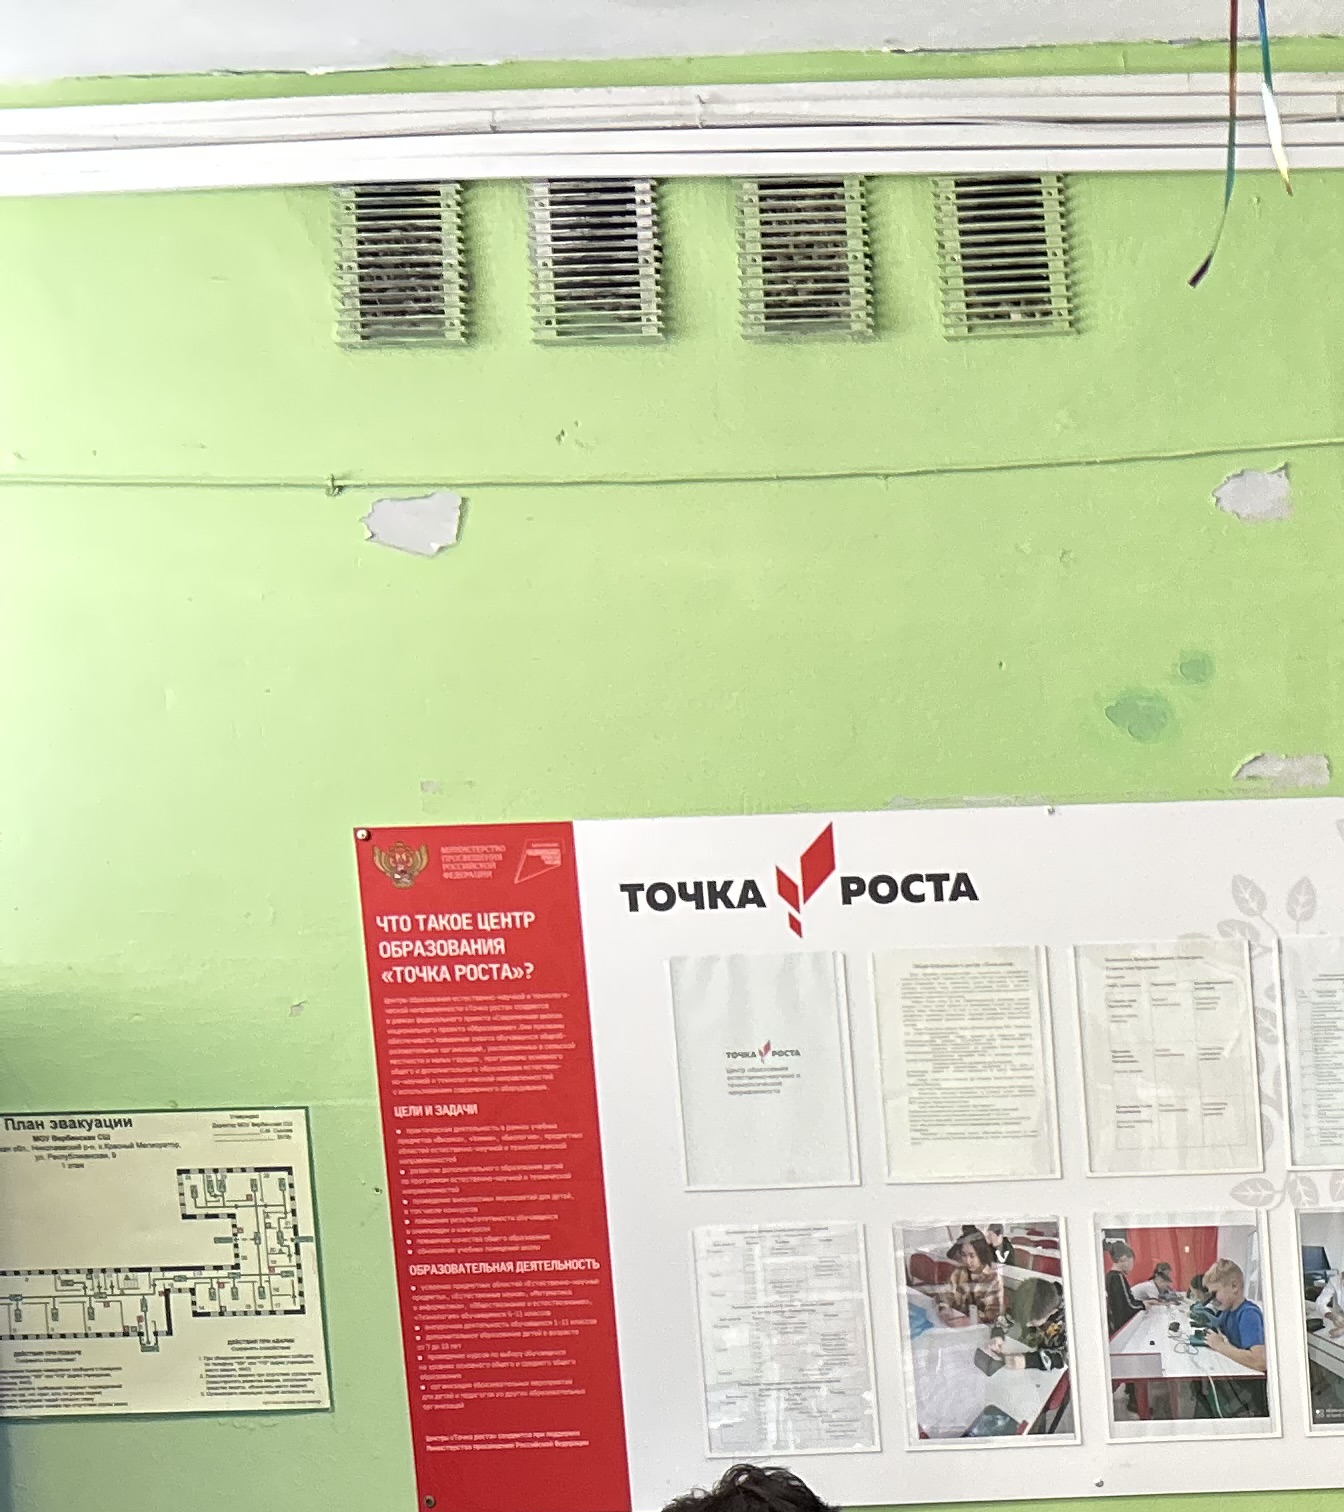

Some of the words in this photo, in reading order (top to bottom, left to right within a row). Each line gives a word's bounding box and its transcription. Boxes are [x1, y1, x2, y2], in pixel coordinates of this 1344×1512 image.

[620, 880, 767, 912] ТОЧКА
[840, 873, 979, 905] РОСТА
[376, 914, 412, 932] ЧТО
[415, 912, 473, 931] ТАКОЕ
[477, 911, 536, 930] ЦЕНТР
[379, 938, 506, 958] ОБРАЗОВАНИЯ
[381, 964, 451, 983] «ТОЧКА
[455, 962, 534, 982] РОСТА»?
[726, 1051, 757, 1059] ТОЧКА
[771, 1049, 801, 1057] РОСТА
[394, 1103, 424, 1118] ЦЕЛИ
[425, 1103, 434, 1117] И
[434, 1103, 479, 1117] ЗАДАЧИ
[4, 1117, 46, 1131] План
[50, 1117, 134, 1133] эвакуации
[409, 1262, 514, 1277] ОБРАЗОВАТЕЛЬНАЯ
[515, 1259, 601, 1274] ДЕЯТЕЛЬНОСТЬ
